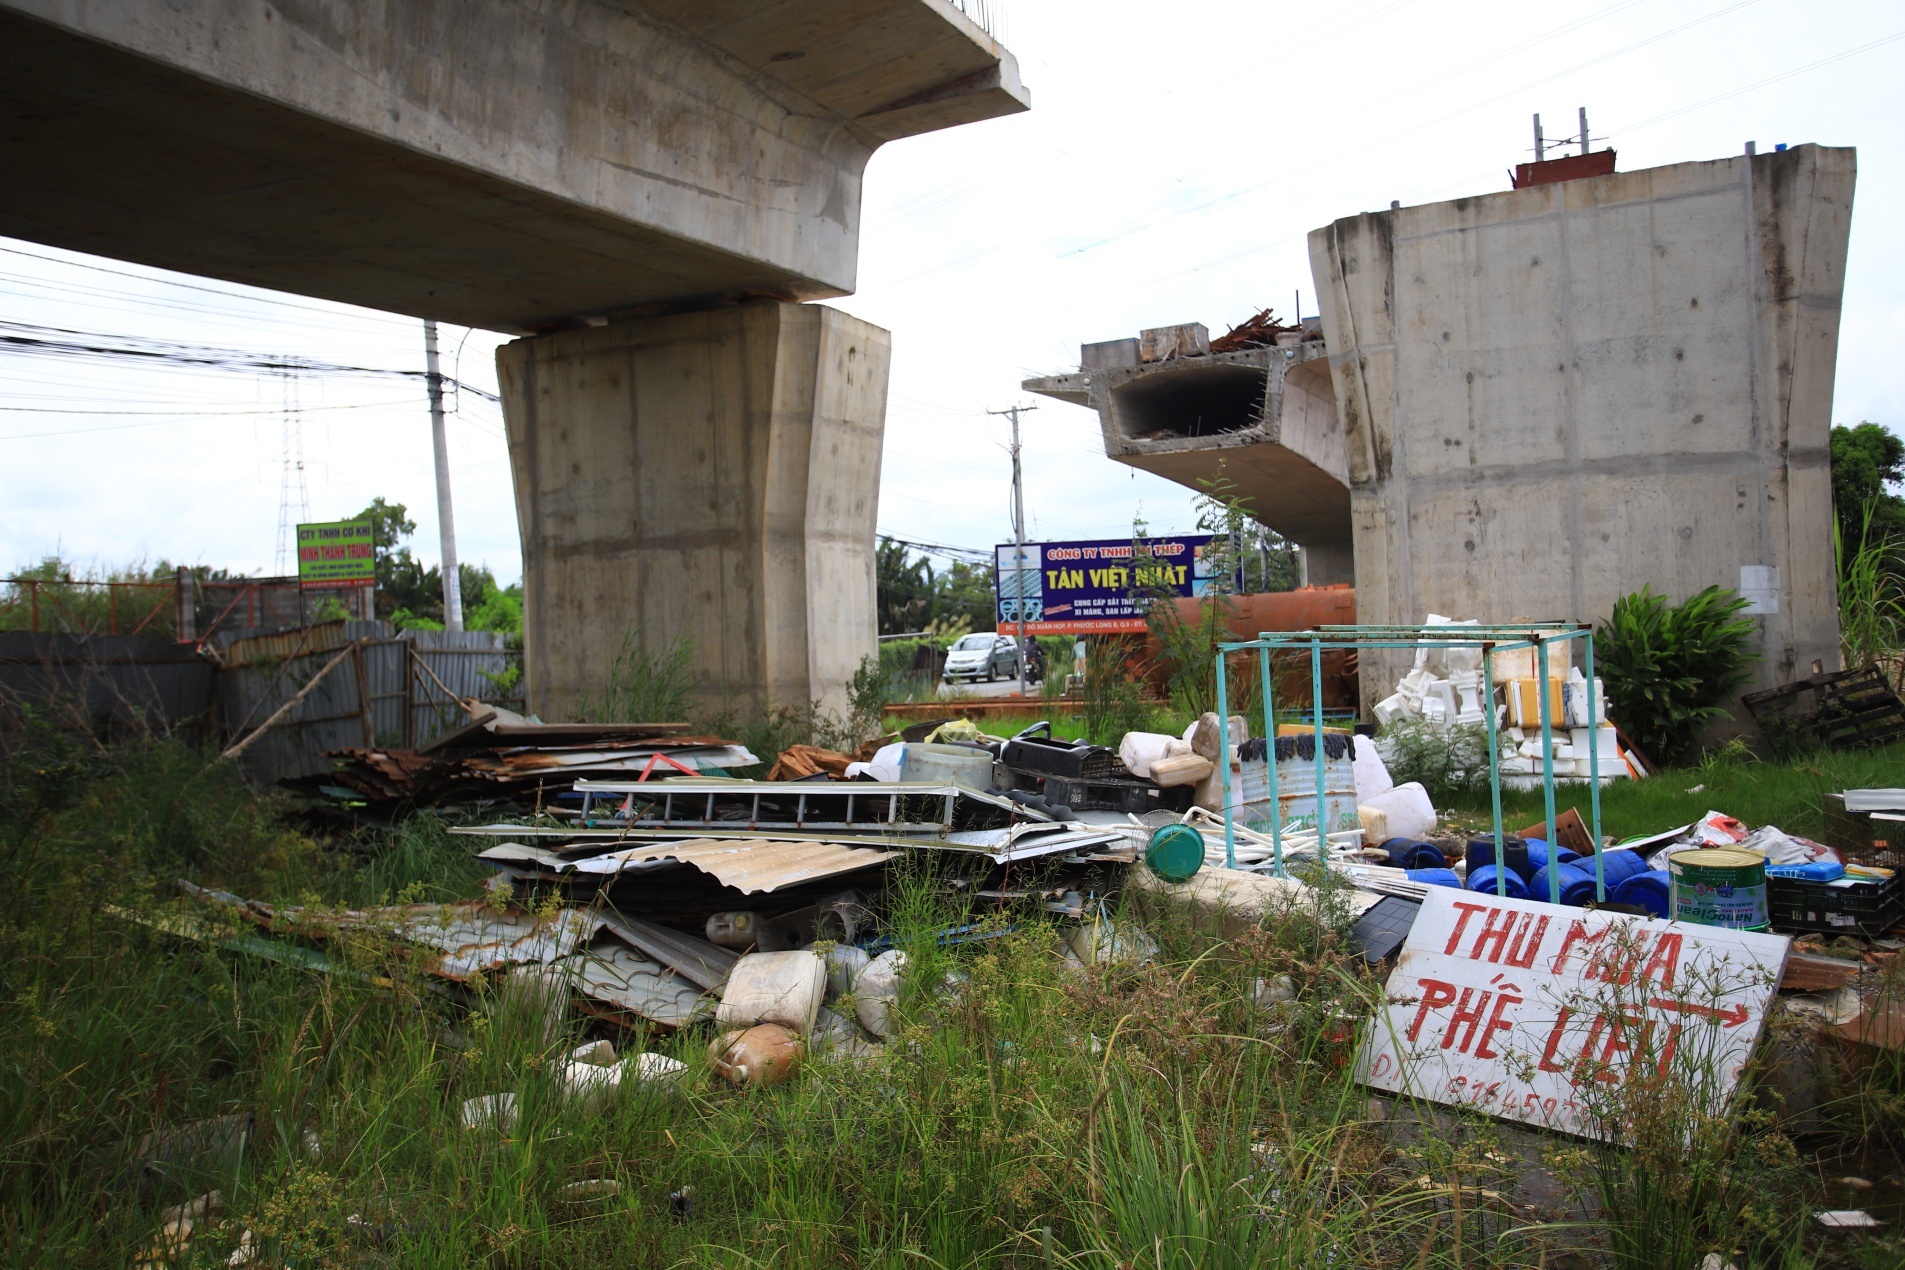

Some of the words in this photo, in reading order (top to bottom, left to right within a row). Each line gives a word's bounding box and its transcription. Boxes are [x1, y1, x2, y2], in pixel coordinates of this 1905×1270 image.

[300, 529, 315, 540] CTY
[318, 528, 340, 539] TNHH
[347, 542, 372, 559] TRUNG
[1047, 547, 1081, 560] CÔNG
[1082, 547, 1098, 559] TY
[1099, 545, 1132, 559] TNHH
[1154, 542, 1185, 556] THÉP
[1046, 566, 1084, 589] TÂN
[1089, 565, 1129, 592] VIỆT
[1074, 599, 1092, 607] CUNG
[1093, 597, 1106, 607] CẤP
[1075, 608, 1082, 616] XI
[1105, 607, 1119, 615] SAN
[1096, 621, 1112, 629] LONG
[1444, 901, 1553, 969] THU
[1552, 919, 1683, 991] MUA
[1407, 973, 1523, 1059] PHẾ
